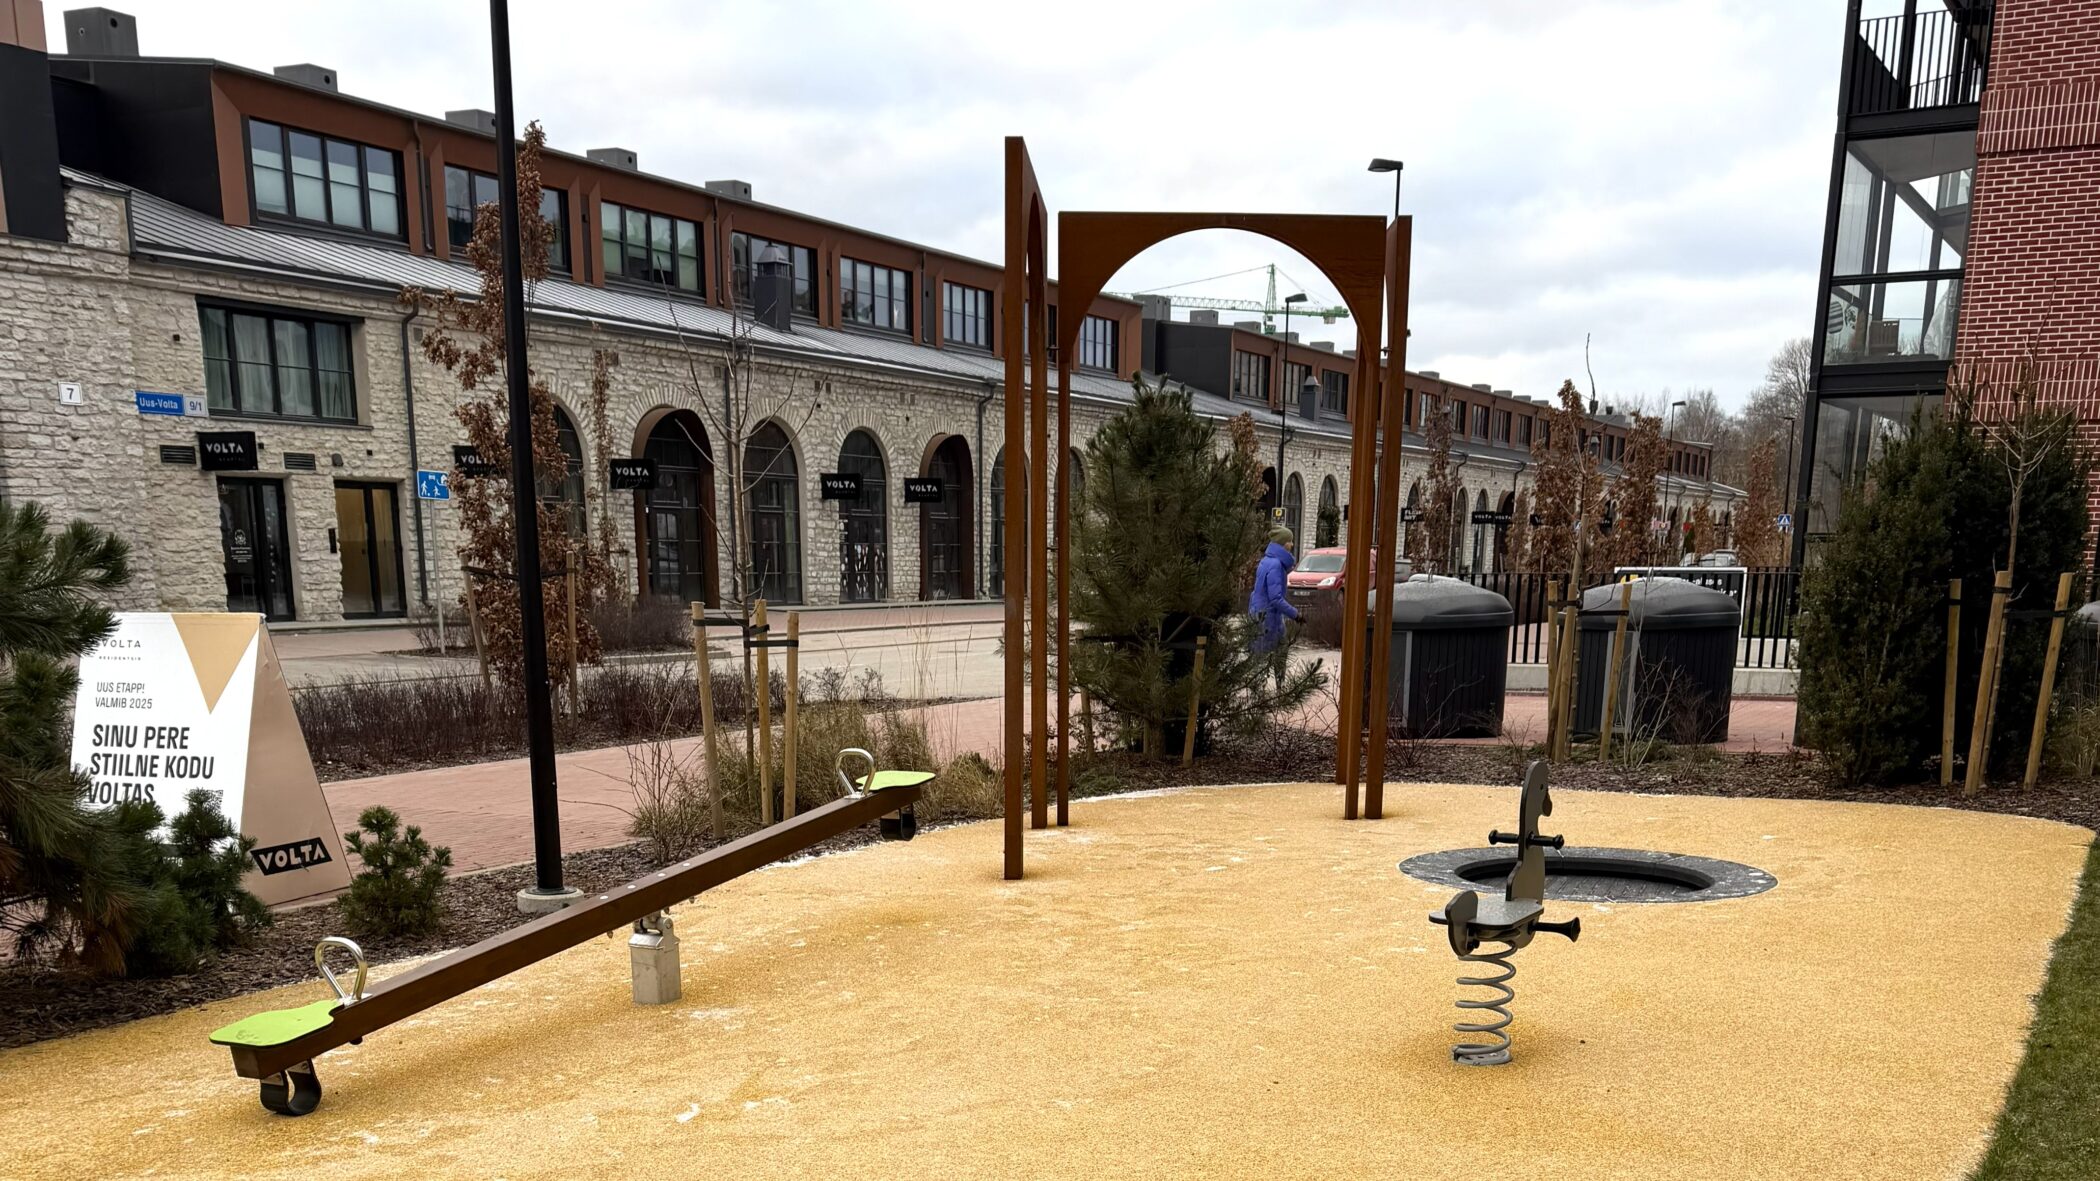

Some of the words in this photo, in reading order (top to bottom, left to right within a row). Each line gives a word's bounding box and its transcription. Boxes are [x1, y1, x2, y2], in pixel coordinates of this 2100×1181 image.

[66, 388, 74, 400] 7
[139, 397, 178, 409] Uus-Volta
[188, 401, 203, 411] 9/1
[206, 442, 244, 454] VOLTA
[461, 455, 488, 465] VOL
[615, 466, 649, 476] VOLTA
[826, 480, 856, 489] VOLTA
[909, 484, 938, 492] VOLTA
[101, 639, 141, 648] VOLTA
[96, 681, 114, 693] UUS
[116, 682, 145, 694] ETAPP!
[95, 697, 127, 708] VALMIB
[129, 698, 153, 709] 2025
[92, 723, 138, 748] SINU
[143, 726, 190, 750] PERE
[89, 752, 160, 778] STIILNE
[164, 755, 215, 780] KODU
[87, 781, 155, 805] VOLTAS
[258, 843, 326, 871] VOLTA
